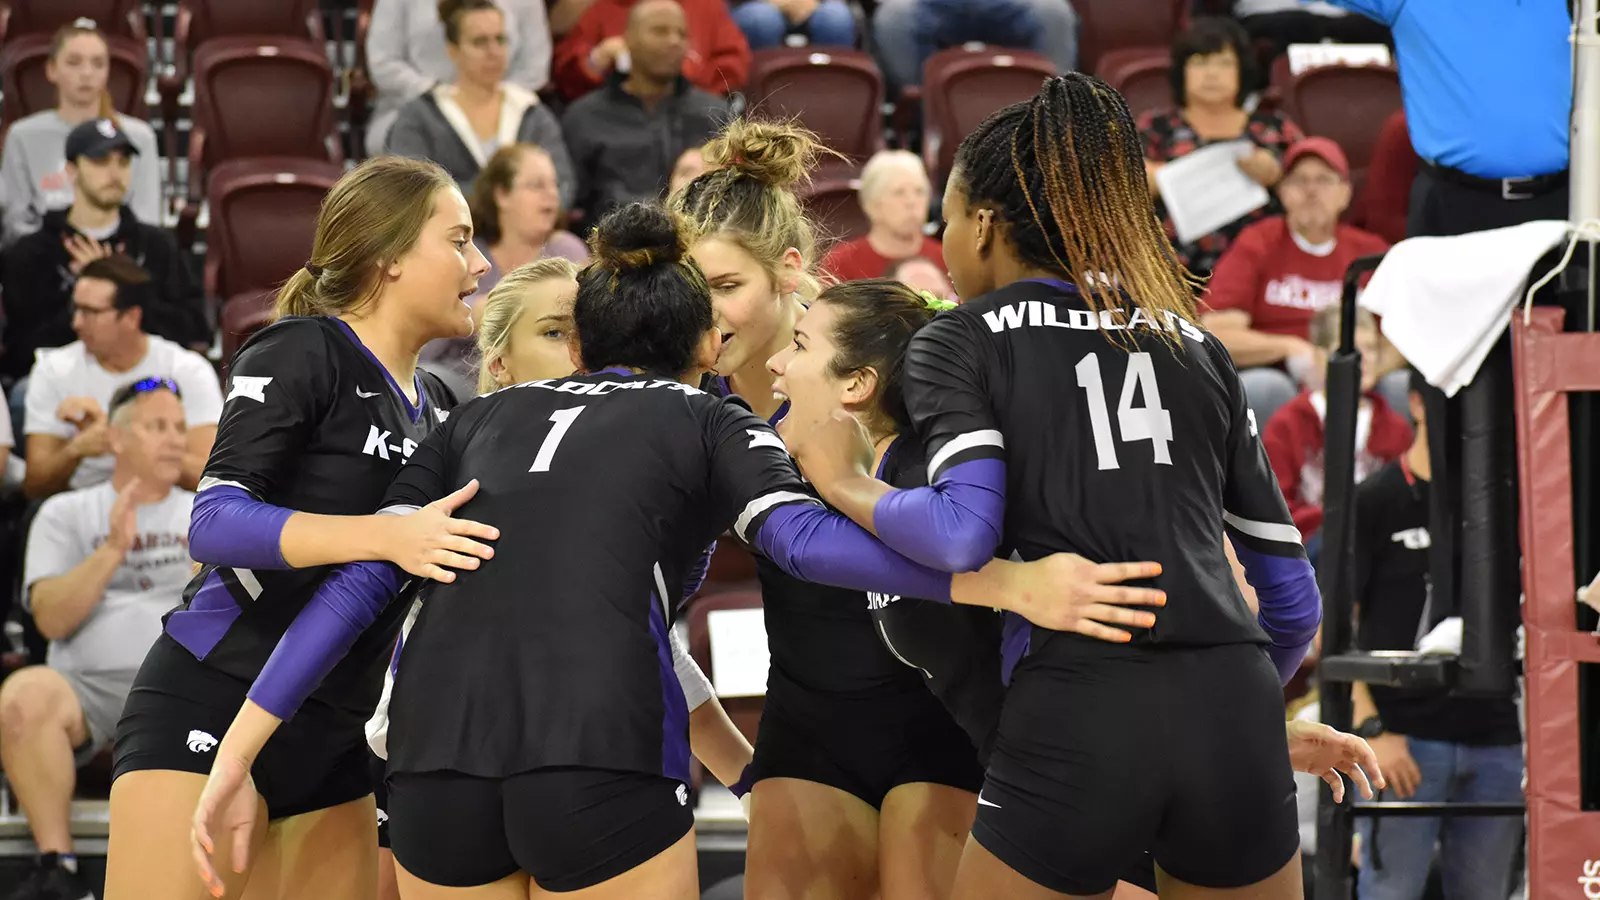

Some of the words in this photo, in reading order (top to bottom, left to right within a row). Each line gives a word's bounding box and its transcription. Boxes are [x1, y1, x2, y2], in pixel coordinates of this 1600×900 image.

[982, 300, 1206, 343] WILDCATS
[528, 404, 587, 473] 1
[1074, 351, 1174, 471] 14
